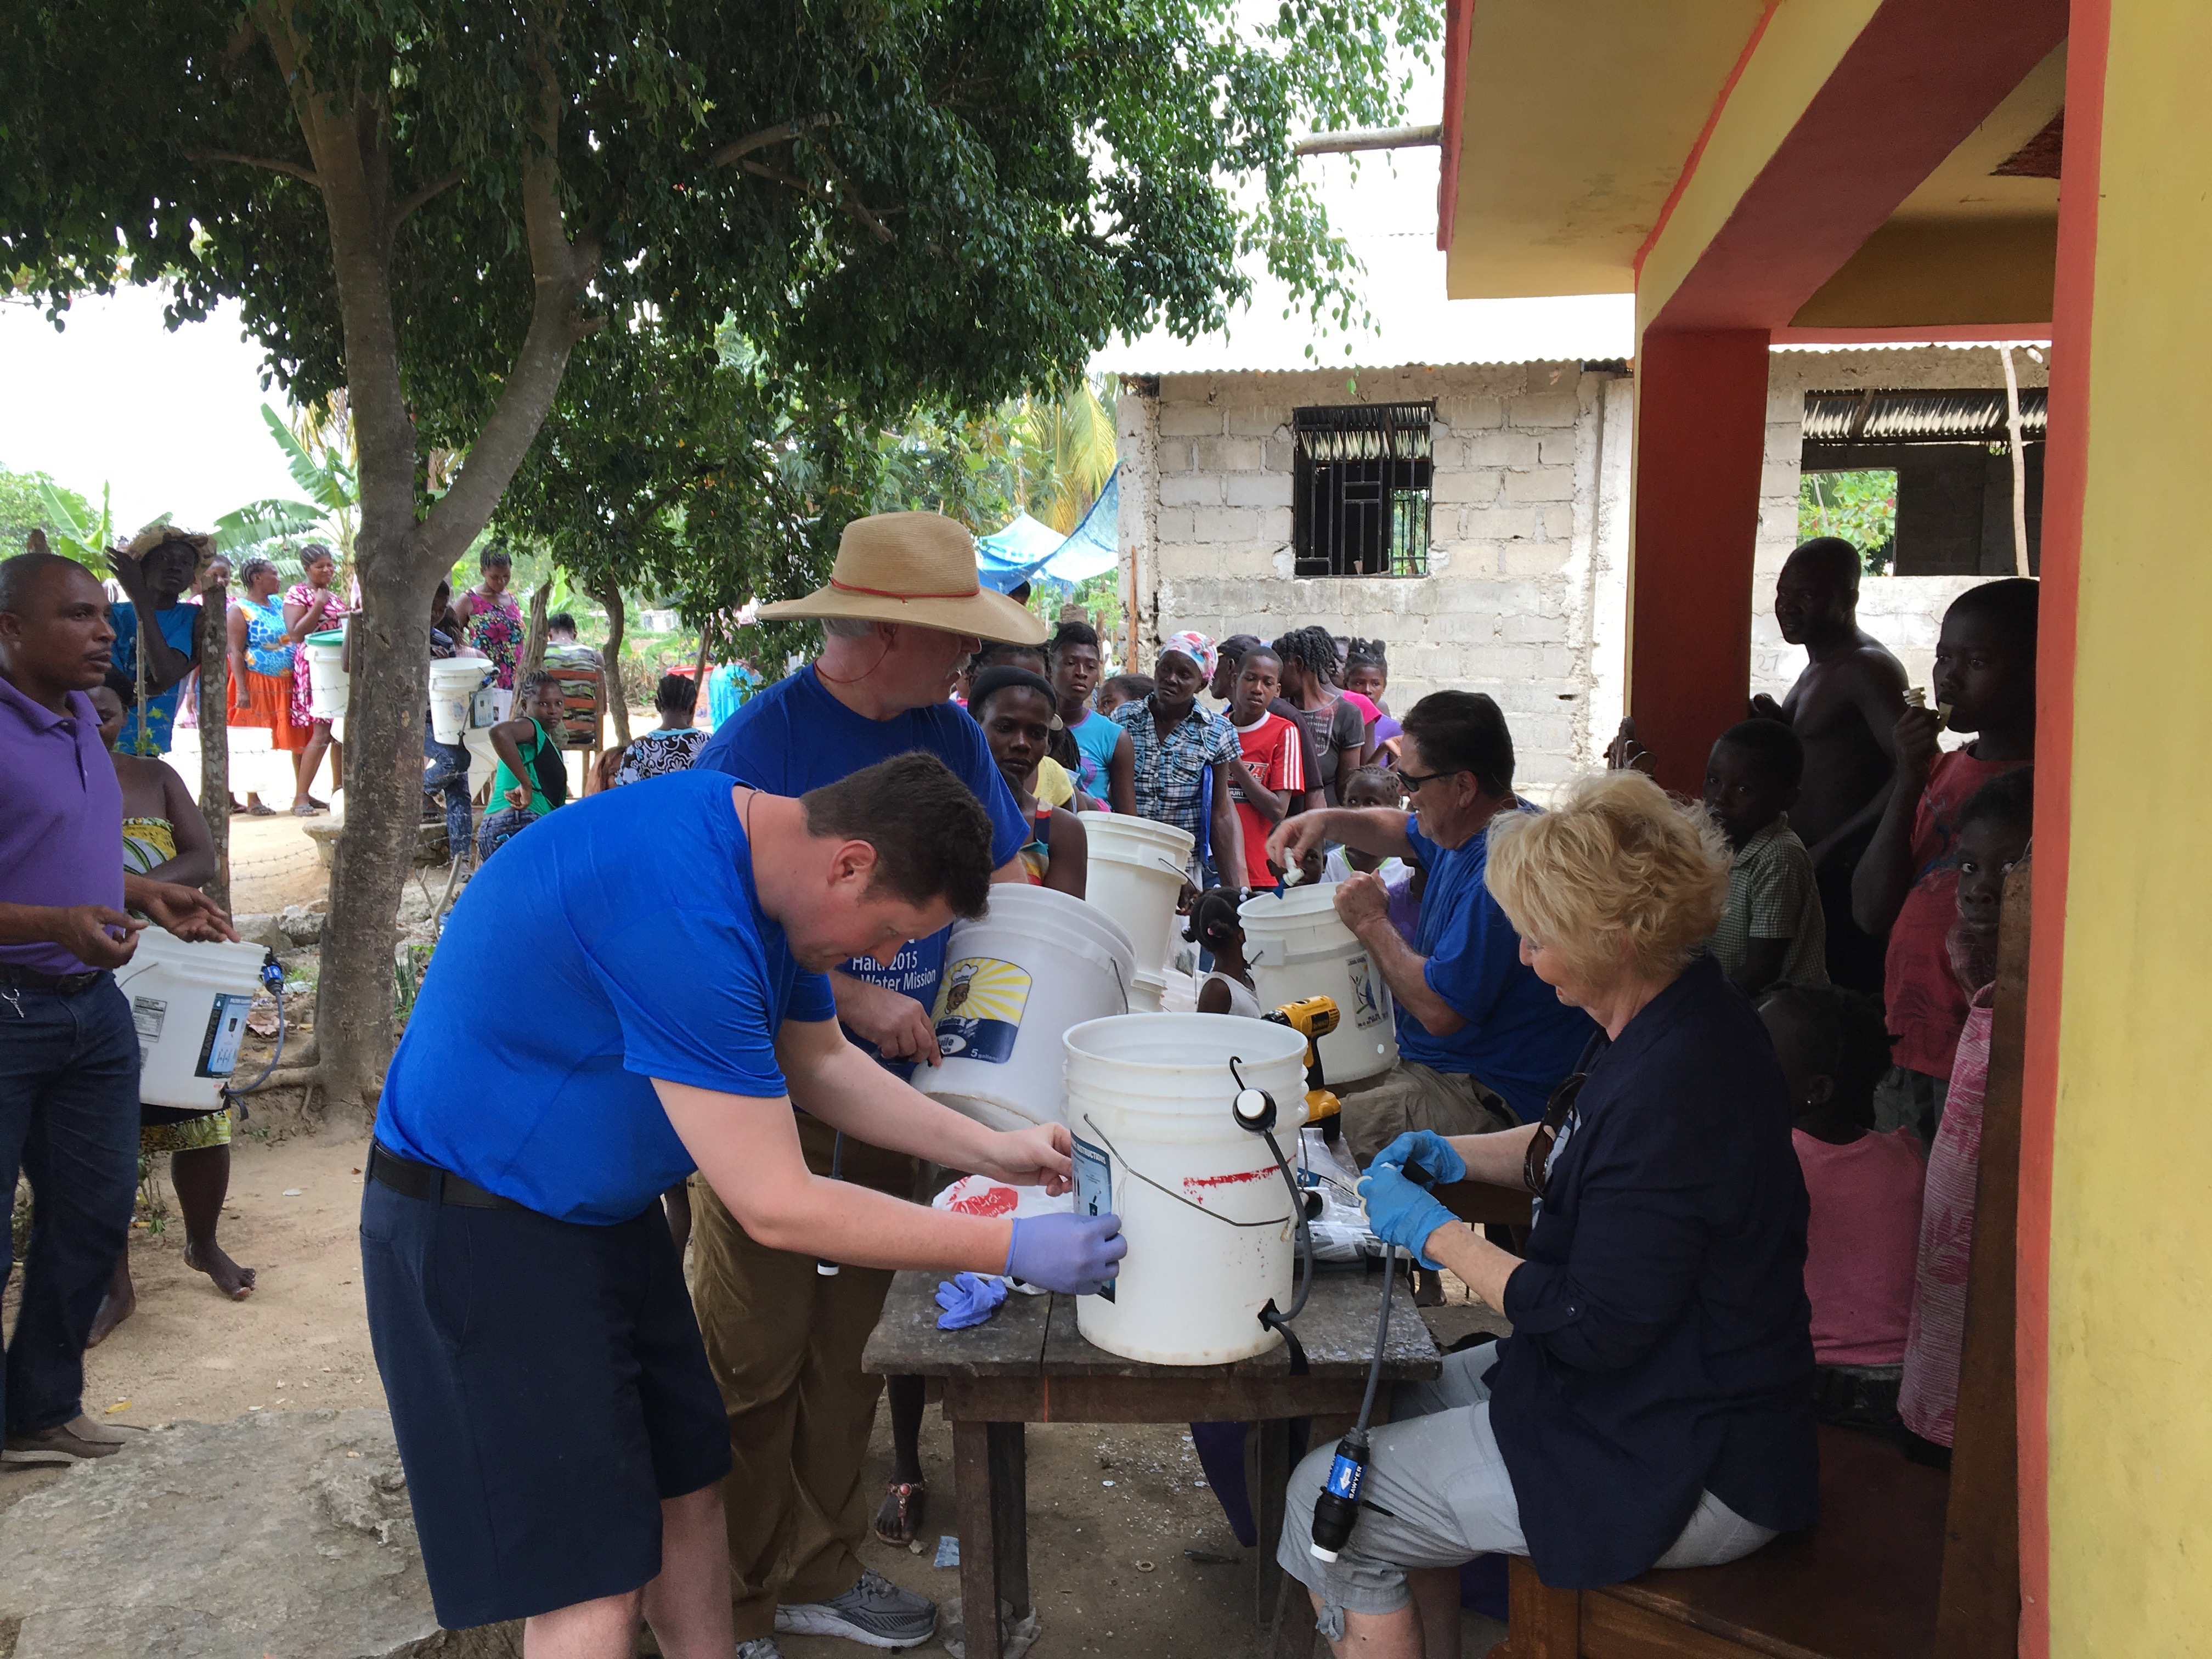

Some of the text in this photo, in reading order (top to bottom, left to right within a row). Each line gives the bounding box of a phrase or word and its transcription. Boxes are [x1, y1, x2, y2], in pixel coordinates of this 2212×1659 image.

[1756, 653, 1779, 672] 27
[889, 950, 918, 970] 2015
[903, 967, 936, 991] Mission
[938, 1037, 954, 1047] uile
[970, 1048, 979, 1057] 5
[1348, 1465, 1363, 1499] SAWYER
